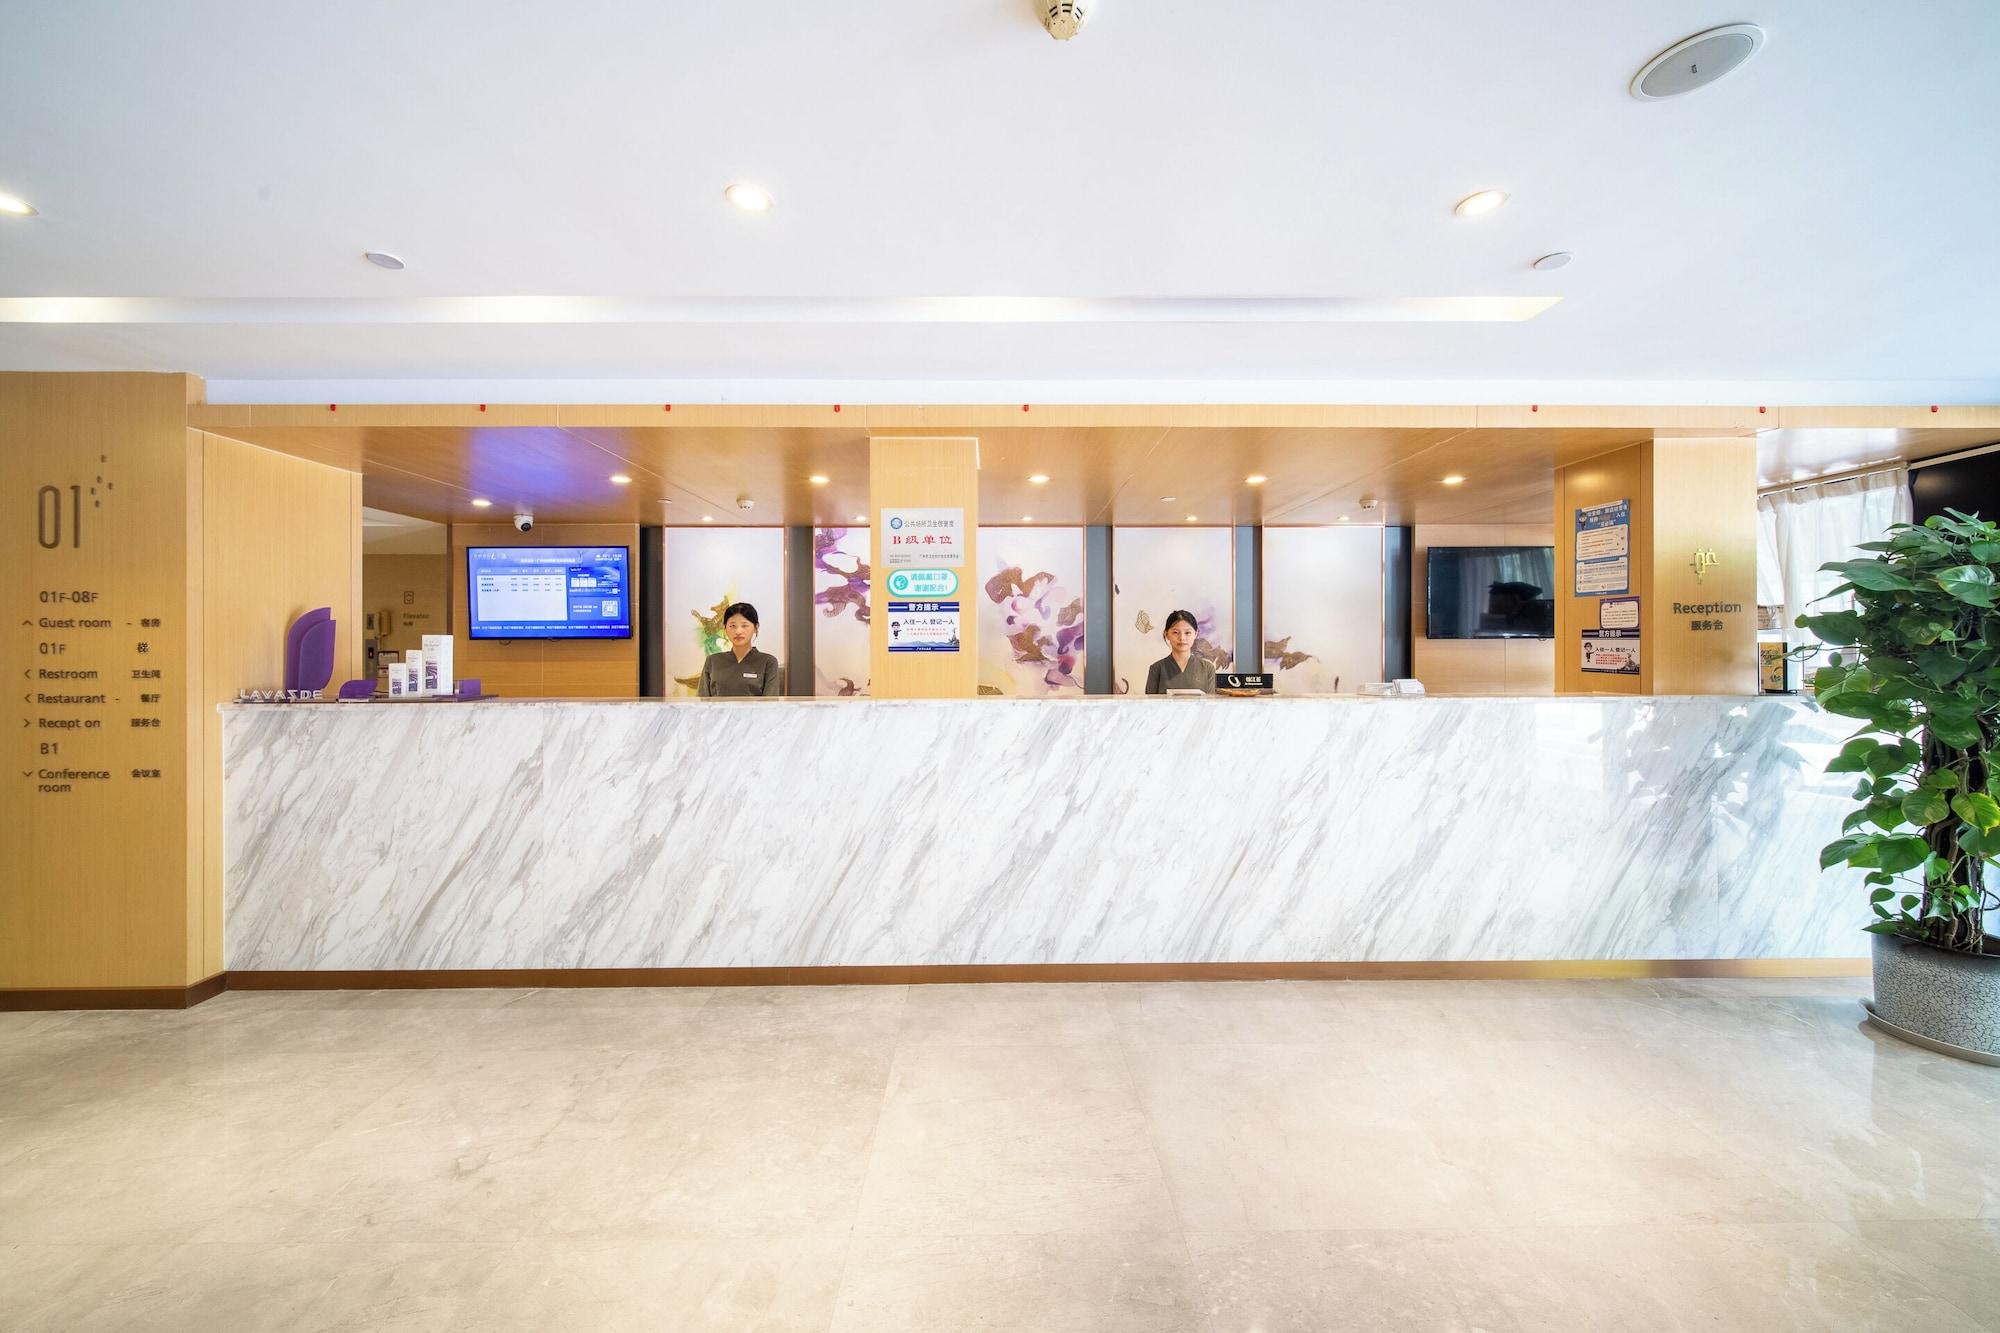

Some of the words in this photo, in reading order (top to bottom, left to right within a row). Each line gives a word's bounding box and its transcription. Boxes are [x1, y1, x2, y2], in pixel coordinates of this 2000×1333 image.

[38, 485, 80, 549] 01
[908, 603, 939, 611] 警方提示
[1673, 601, 1742, 615] Reception
[39, 617, 74, 628] Guest
[79, 619, 112, 628] room
[1691, 619, 1723, 631] 服务台
[40, 642, 66, 655] 01F
[39, 668, 98, 679] Restroom
[37, 693, 106, 703] Restaurant
[40, 742, 59, 754] B1
[38, 768, 110, 779] Conference
[38, 783, 71, 792] room
